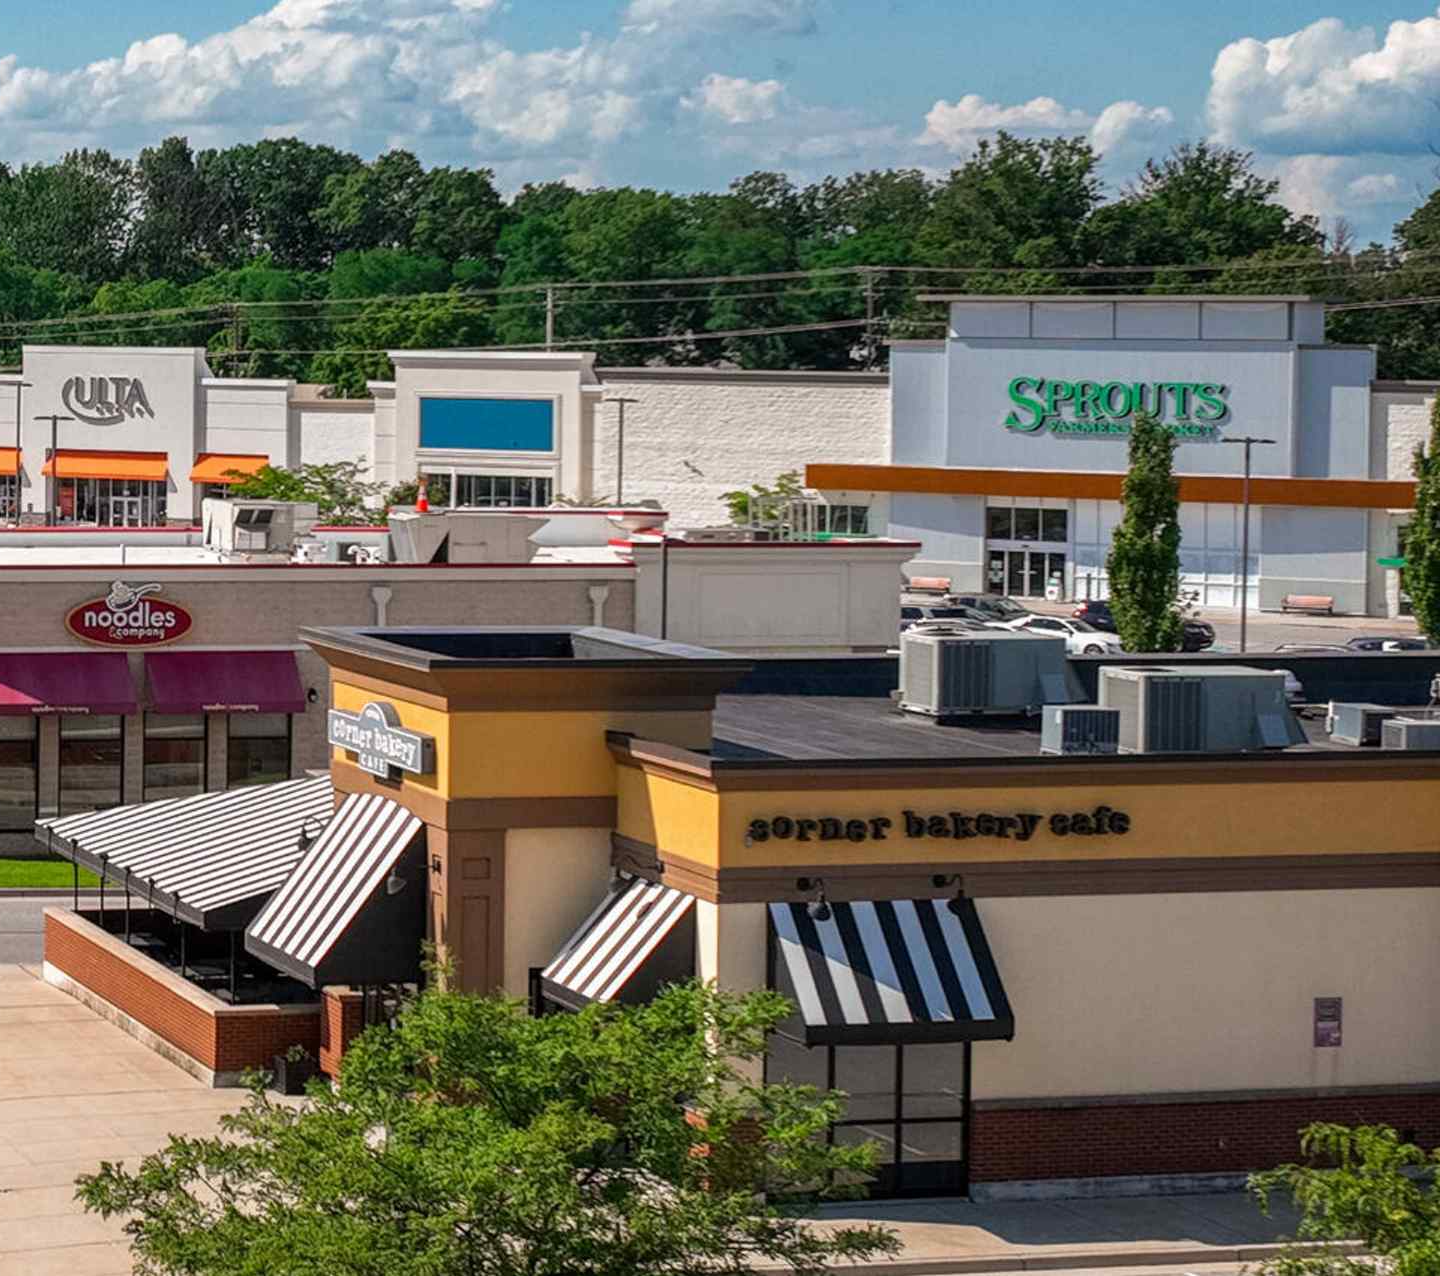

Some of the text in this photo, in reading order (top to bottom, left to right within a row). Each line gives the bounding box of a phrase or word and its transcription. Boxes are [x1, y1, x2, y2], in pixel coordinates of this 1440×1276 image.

[67, 376, 155, 422] ULTA
[1005, 376, 1227, 432] SPROUTS
[84, 602, 176, 628] noodles
[333, 719, 417, 766] corner bakery
[749, 805, 1131, 843] corner bakery cafe
